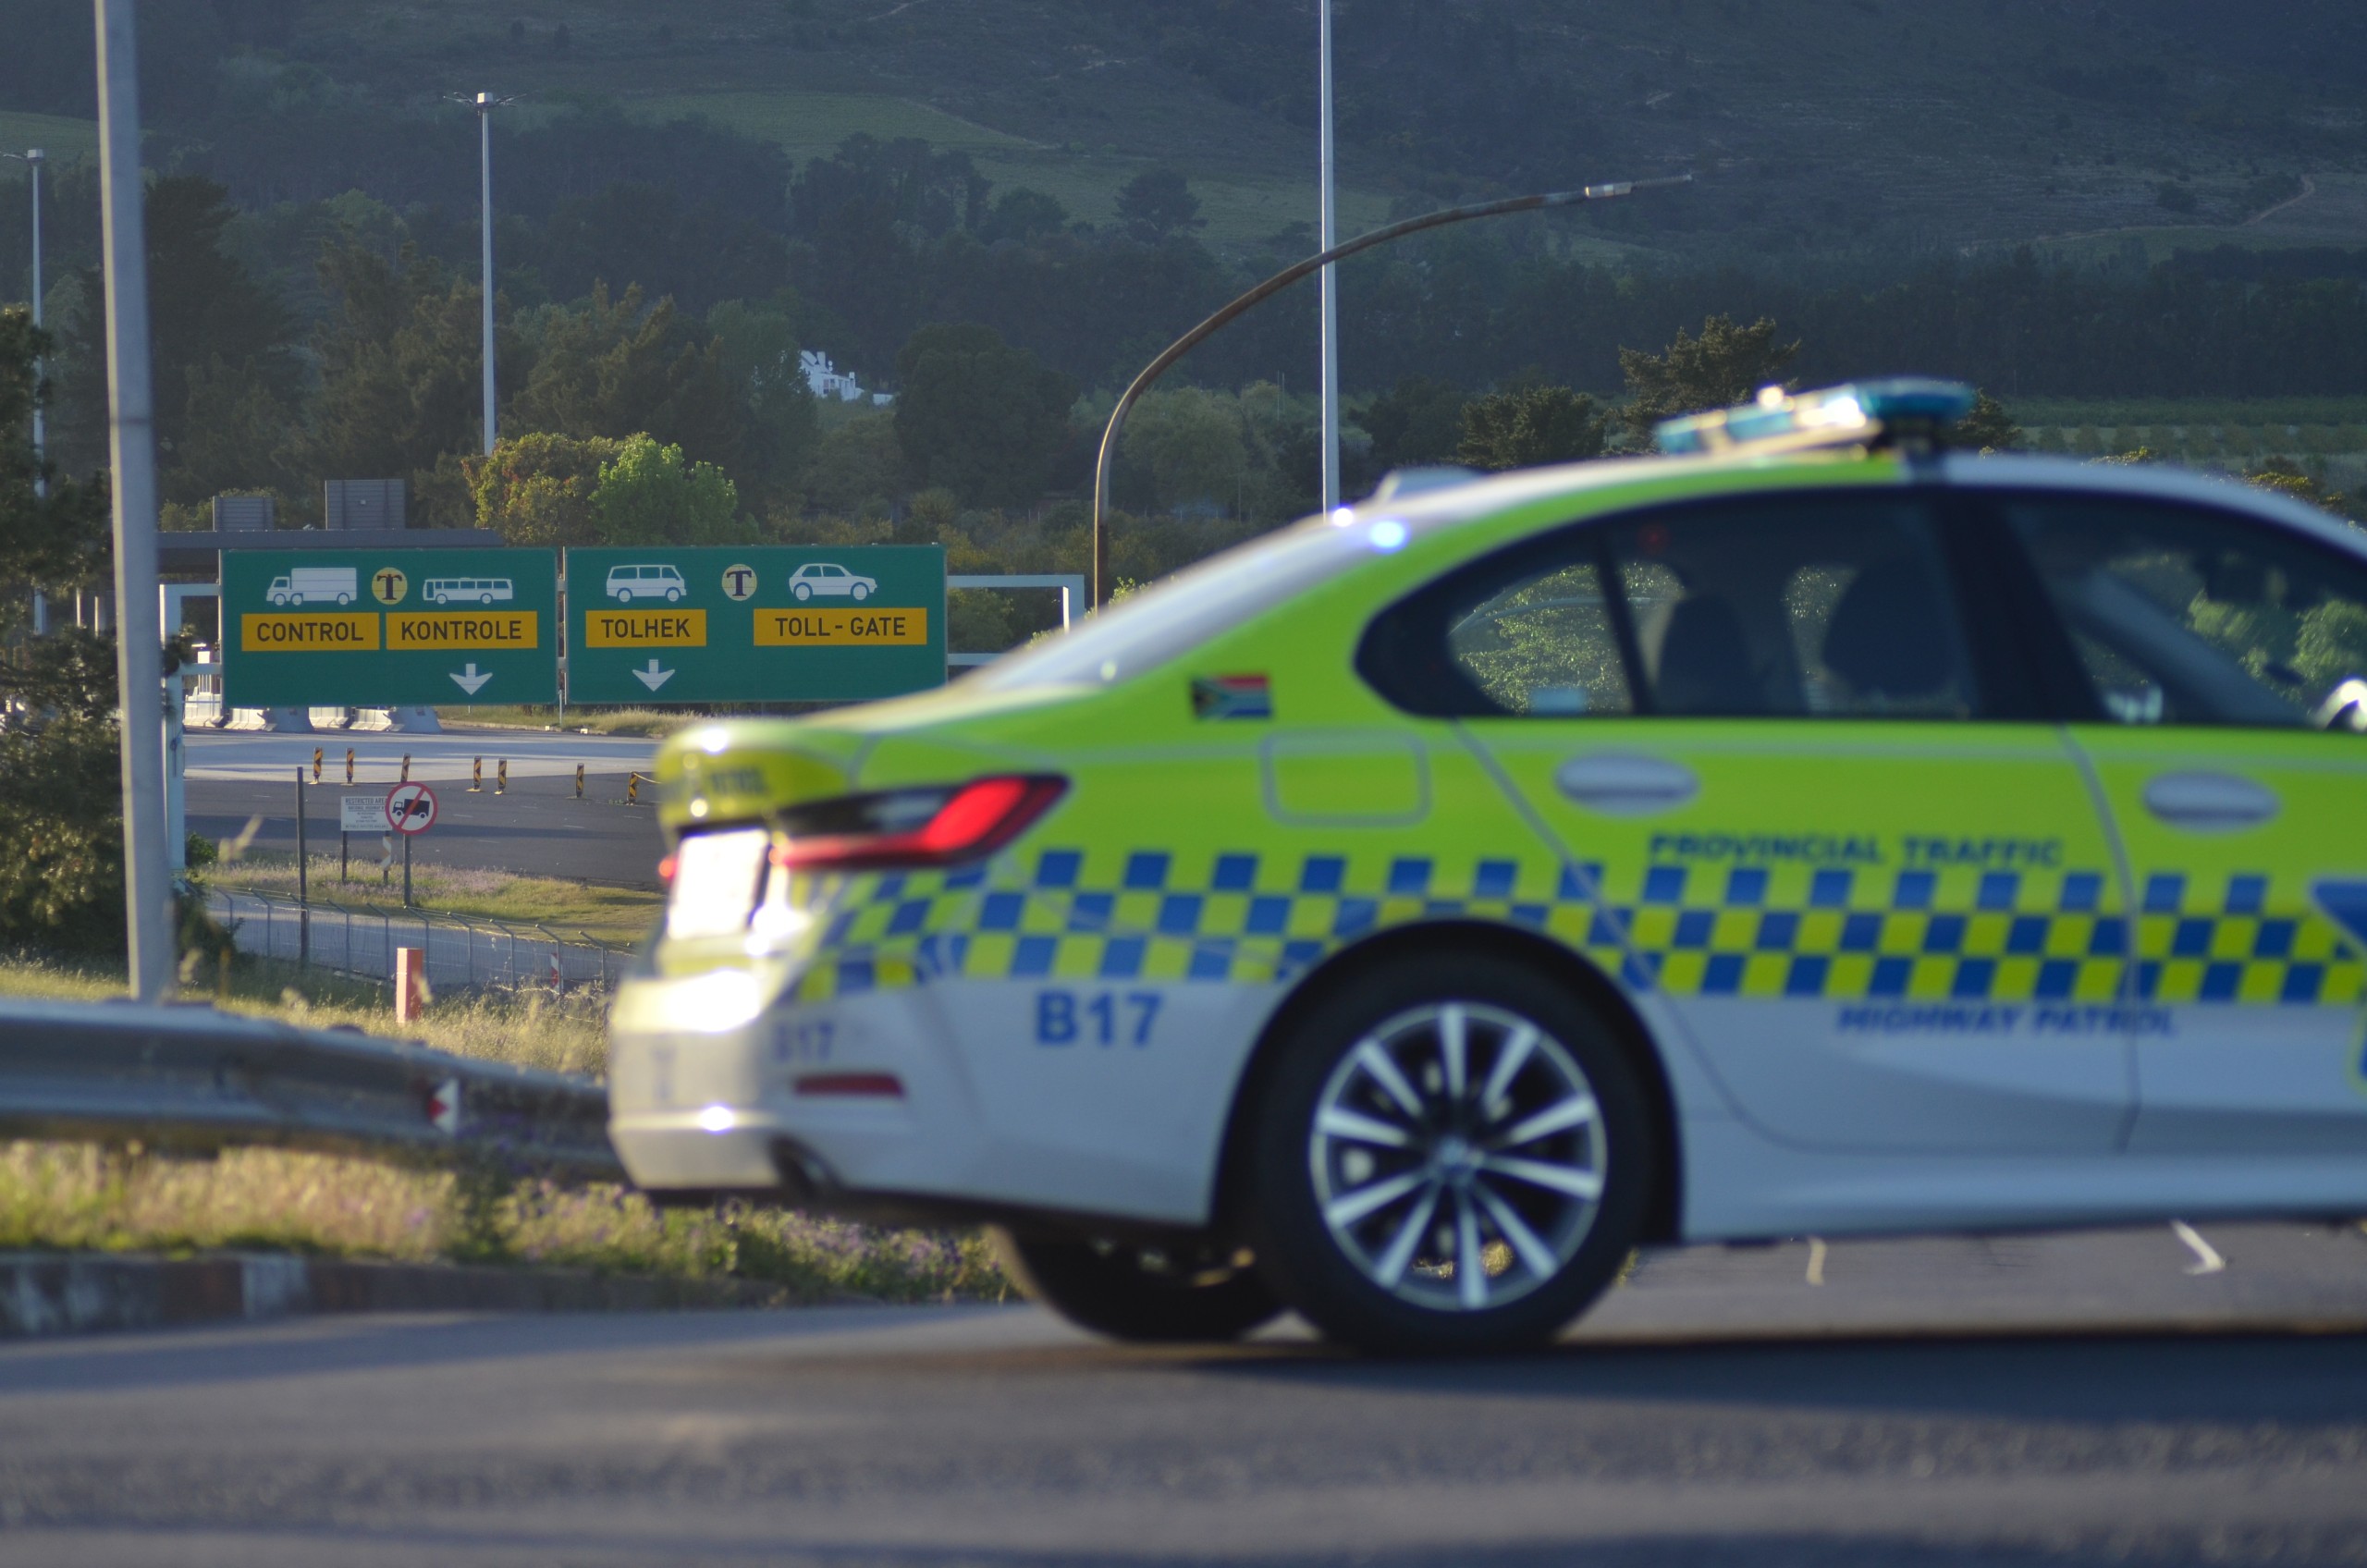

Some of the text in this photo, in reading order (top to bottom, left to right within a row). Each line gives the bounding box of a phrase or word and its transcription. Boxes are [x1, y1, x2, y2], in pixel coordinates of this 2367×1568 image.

[256, 619, 522, 643] CONTROL KONTROLE
[601, 618, 691, 639] TOLHEK
[1650, 834, 2064, 867] PROVINCIAL TRAFFIC
[1036, 991, 1162, 1046] B17
[1837, 1006, 2179, 1037] HIGHWAY PATROL
